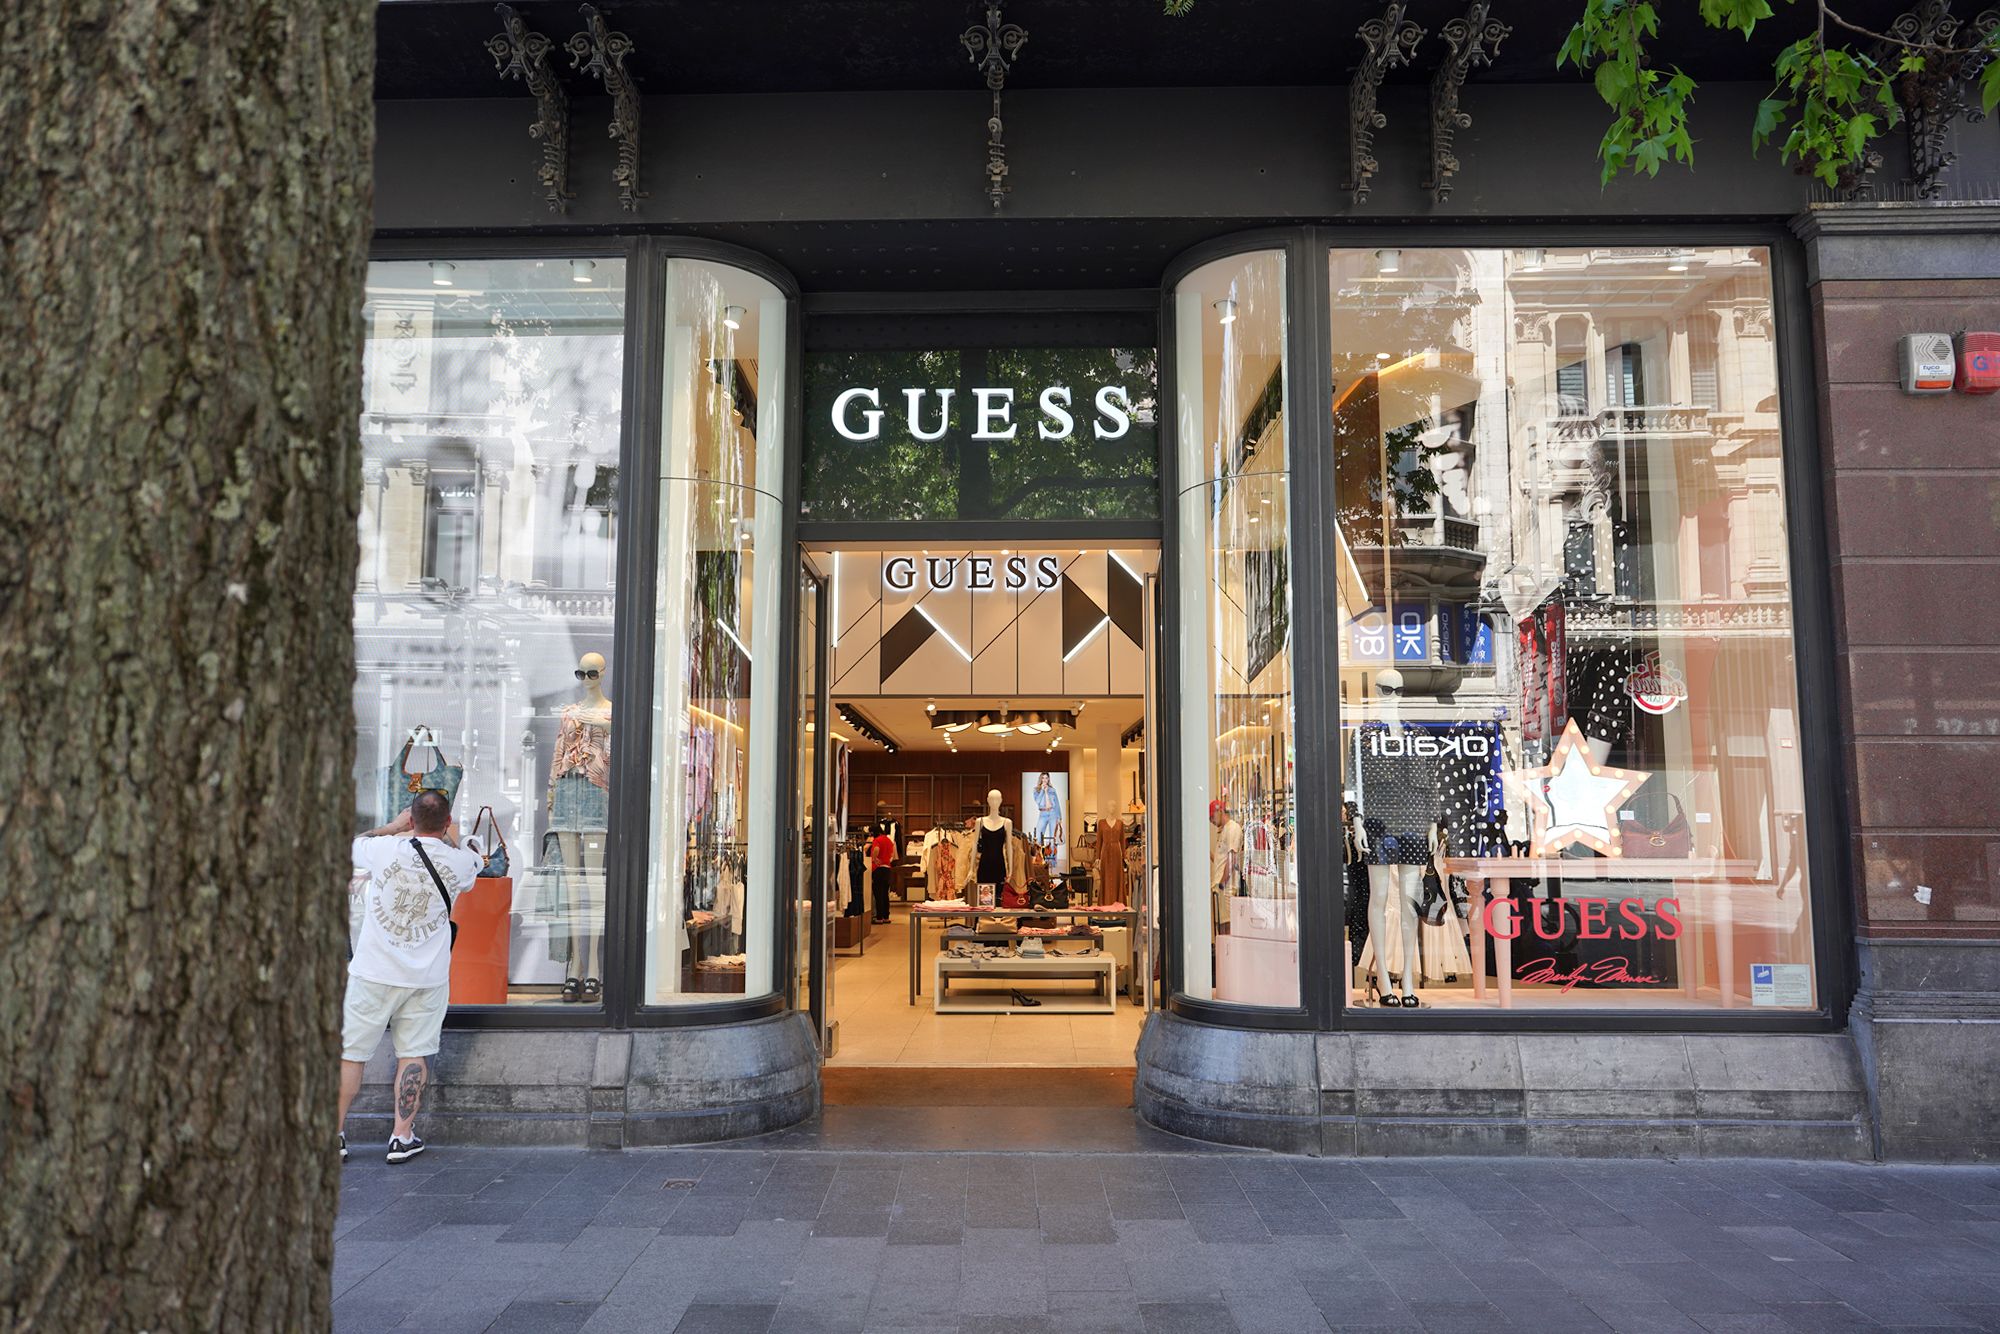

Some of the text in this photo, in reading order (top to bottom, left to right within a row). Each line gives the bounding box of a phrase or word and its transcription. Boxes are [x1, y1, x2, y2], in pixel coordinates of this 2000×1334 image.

[831, 386, 1131, 442] GUESS
[885, 556, 1062, 590] GUESS
[1483, 897, 1684, 941] GUESS
[1516, 956, 1592, 994] Marilyn
